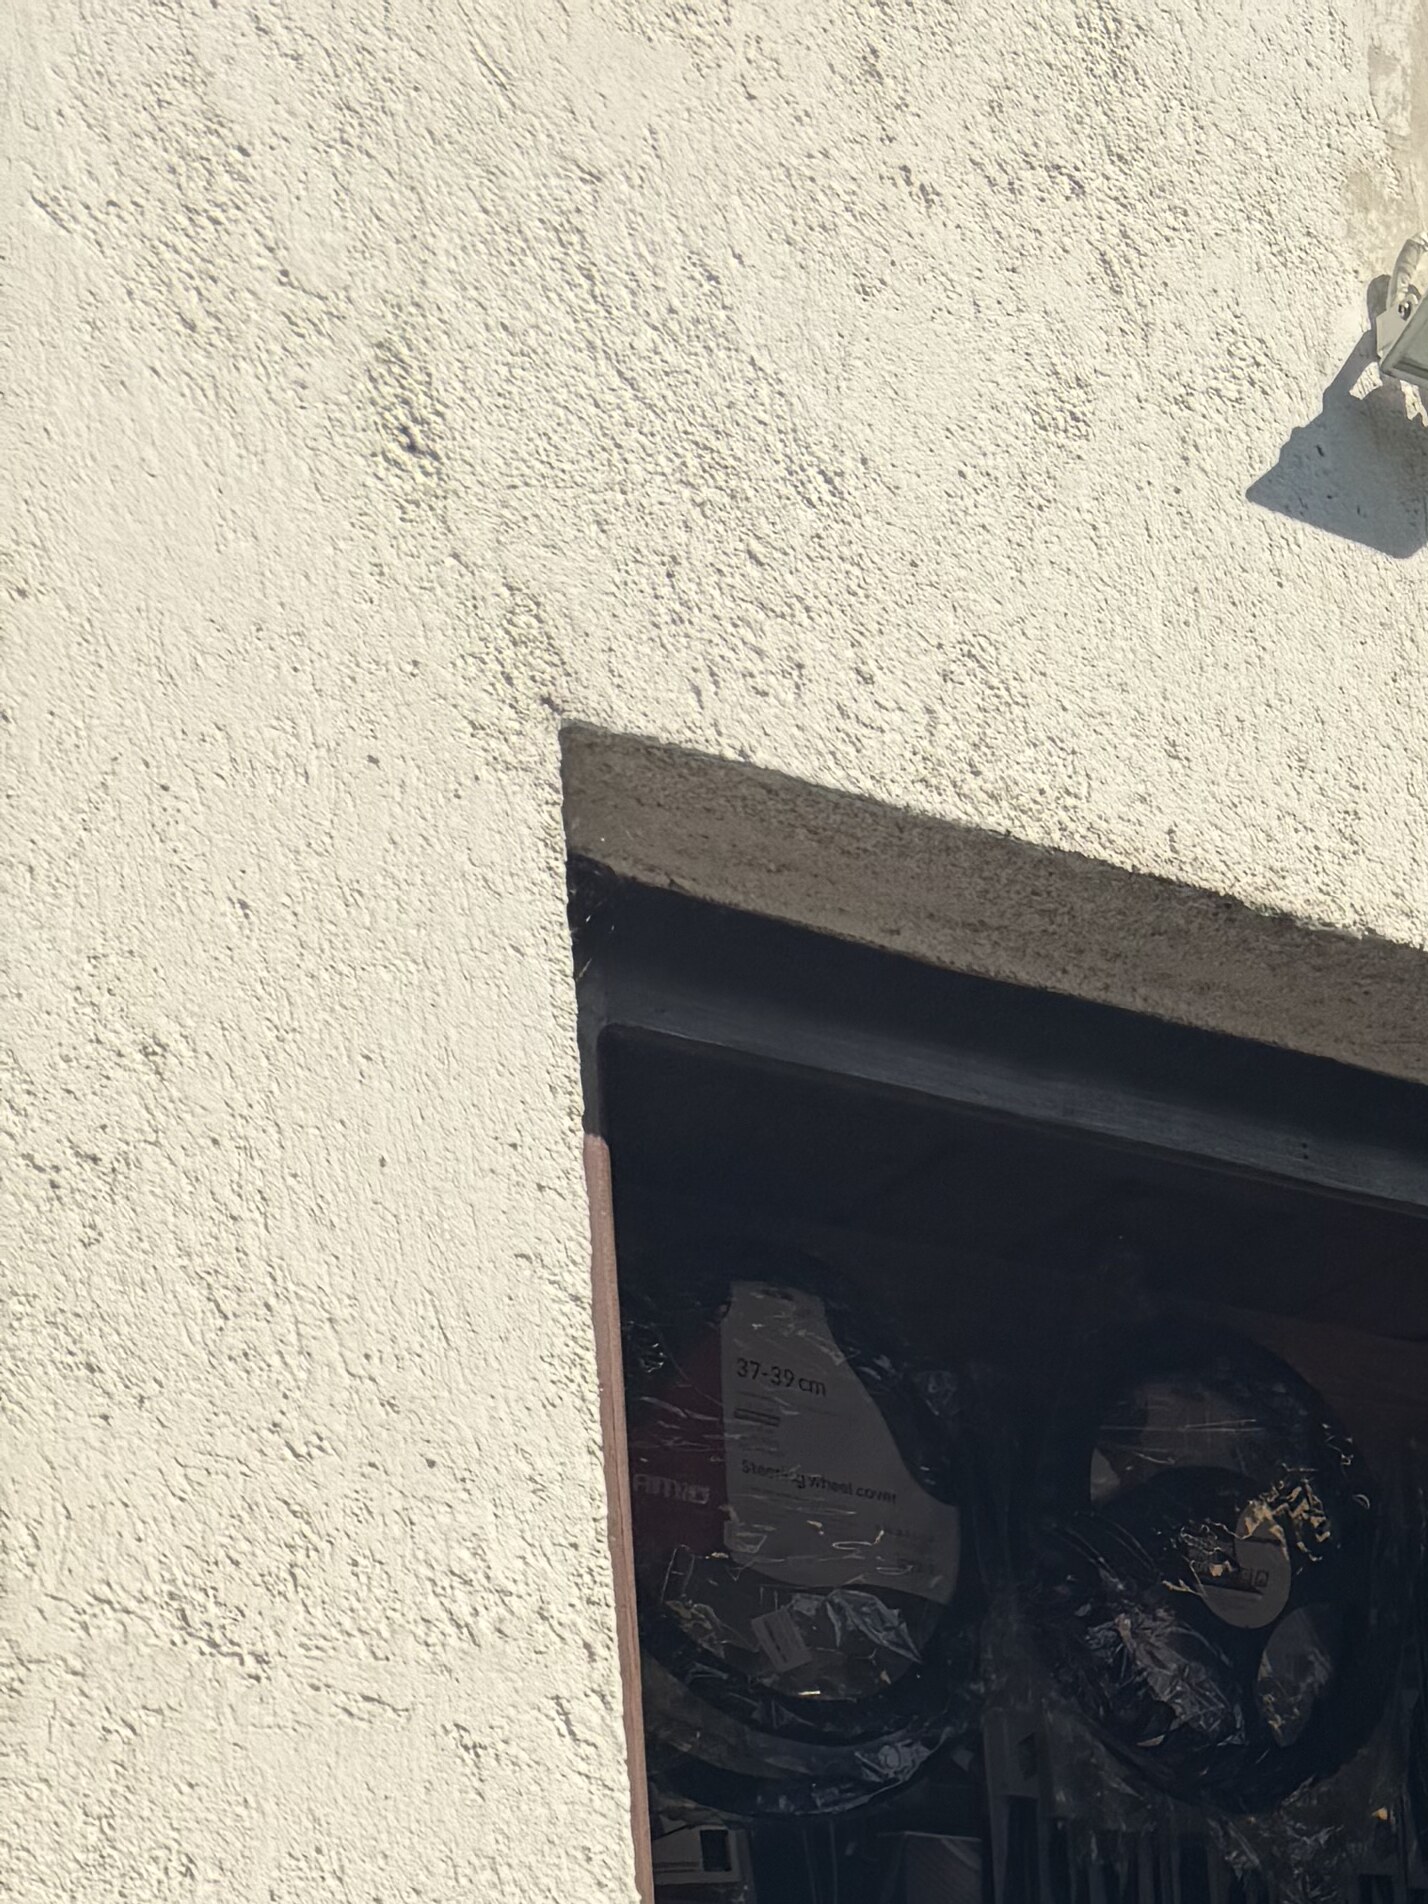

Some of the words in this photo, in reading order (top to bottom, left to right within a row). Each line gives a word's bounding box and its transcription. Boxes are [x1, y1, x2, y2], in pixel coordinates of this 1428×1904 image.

[736, 1358, 794, 1389] 37-39
[799, 1378, 827, 1397] cm
[855, 1486, 897, 1504] cover
